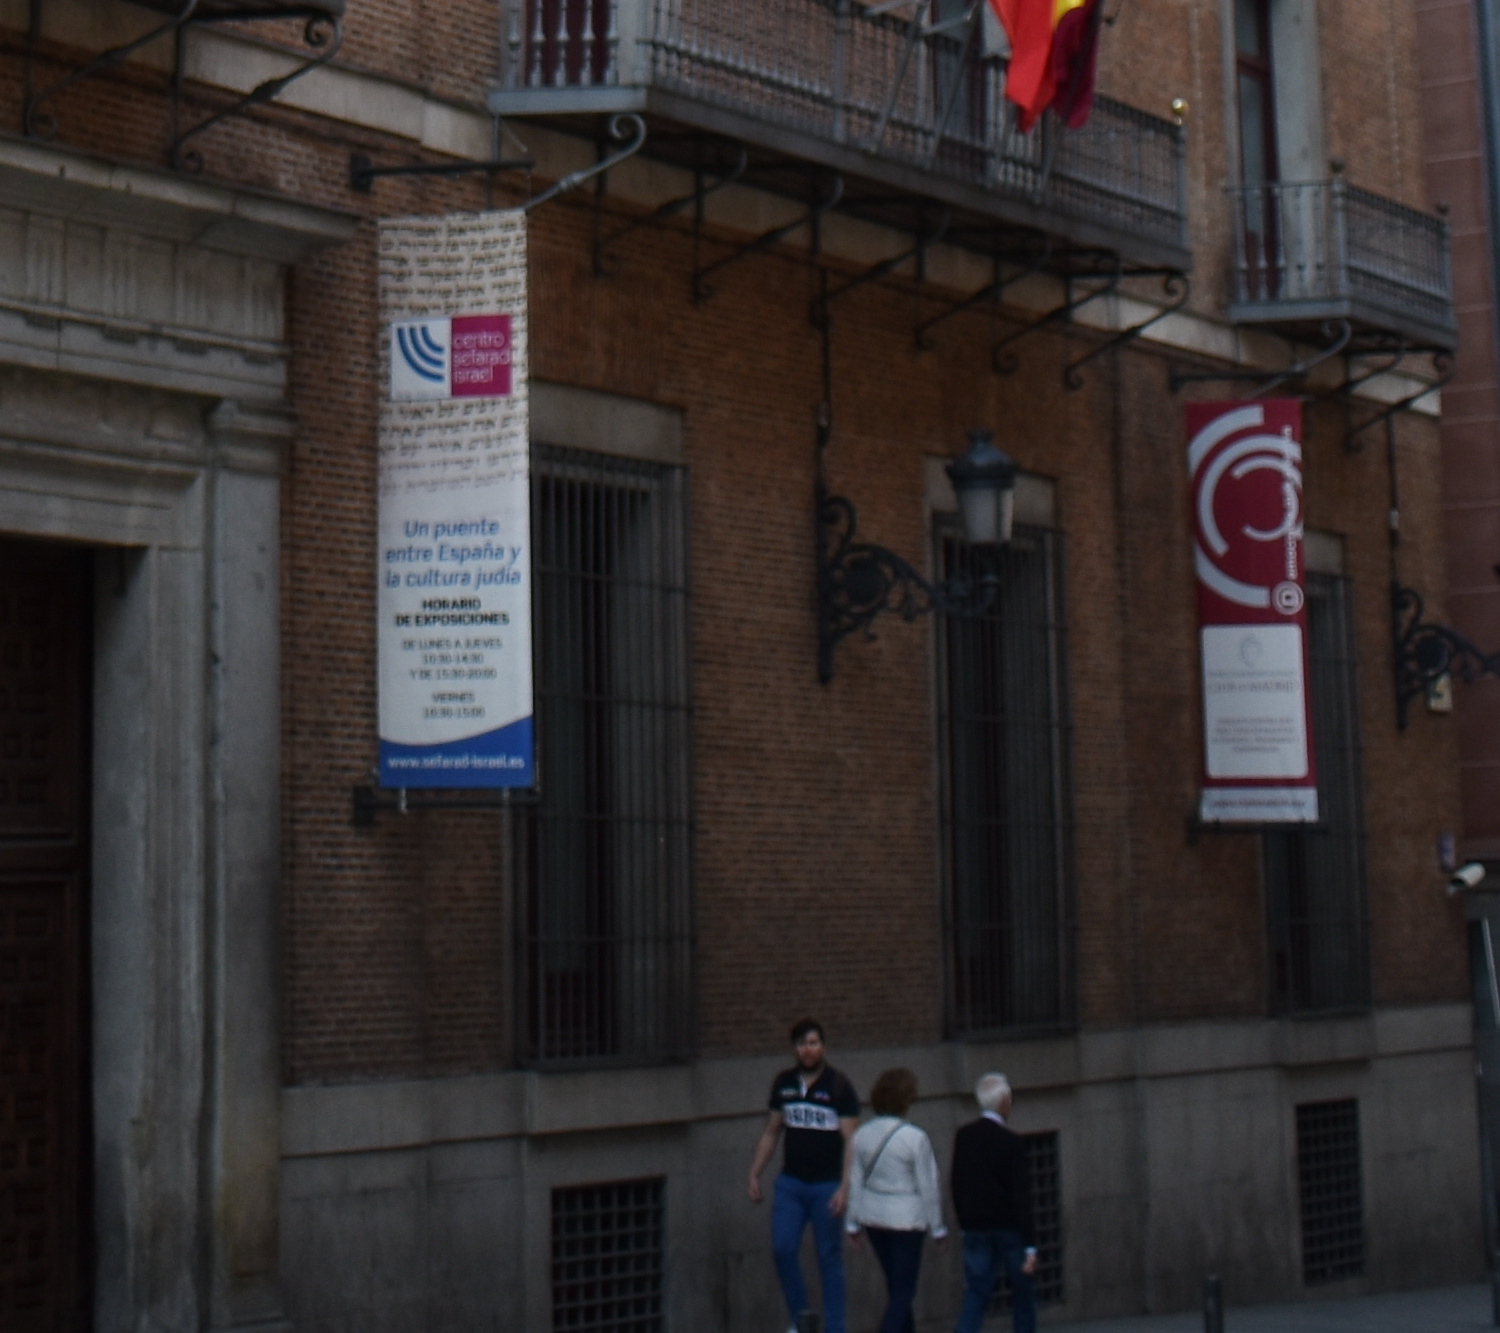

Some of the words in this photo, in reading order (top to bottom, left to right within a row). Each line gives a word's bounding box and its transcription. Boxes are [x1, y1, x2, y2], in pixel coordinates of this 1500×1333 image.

[454, 331, 506, 349] centro
[453, 348, 511, 366] sefarad
[453, 365, 494, 383] israel
[404, 520, 429, 538] Un
[433, 518, 500, 541] puente
[385, 544, 433, 563] entre
[438, 542, 505, 565] España
[511, 546, 521, 565] y
[385, 569, 400, 588] la
[406, 569, 472, 587] cultura
[474, 565, 522, 591] judía
[422, 597, 482, 611] HORARIO
[395, 613, 411, 627] DE
[414, 612, 510, 627] EXPOSICIONES
[454, 637, 463, 649] A
[387, 752, 526, 770] www.sefarad-israel.es
